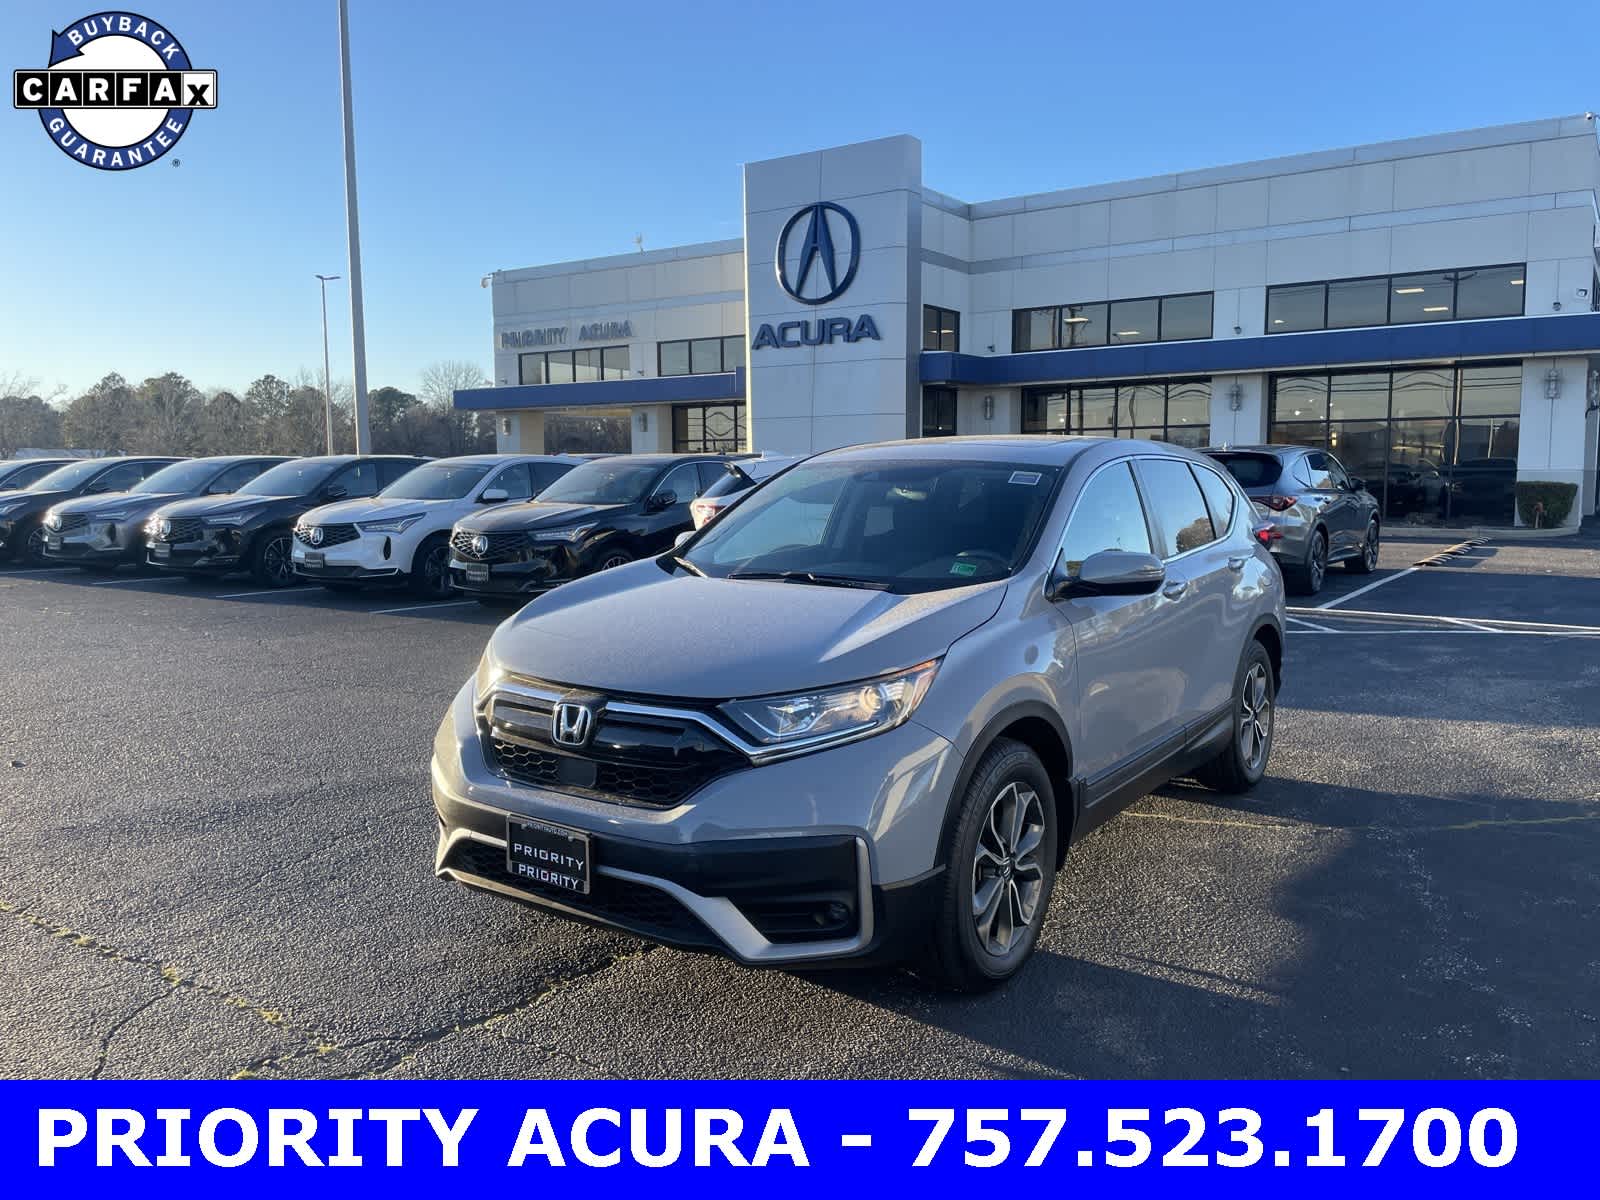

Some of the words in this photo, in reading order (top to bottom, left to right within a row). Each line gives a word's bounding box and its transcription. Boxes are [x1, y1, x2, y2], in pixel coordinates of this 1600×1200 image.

[578, 319, 633, 341] ACURA
[751, 313, 881, 350] ACURA
[513, 843, 584, 871] PRIORITY
[518, 863, 579, 890] PRIORITY
